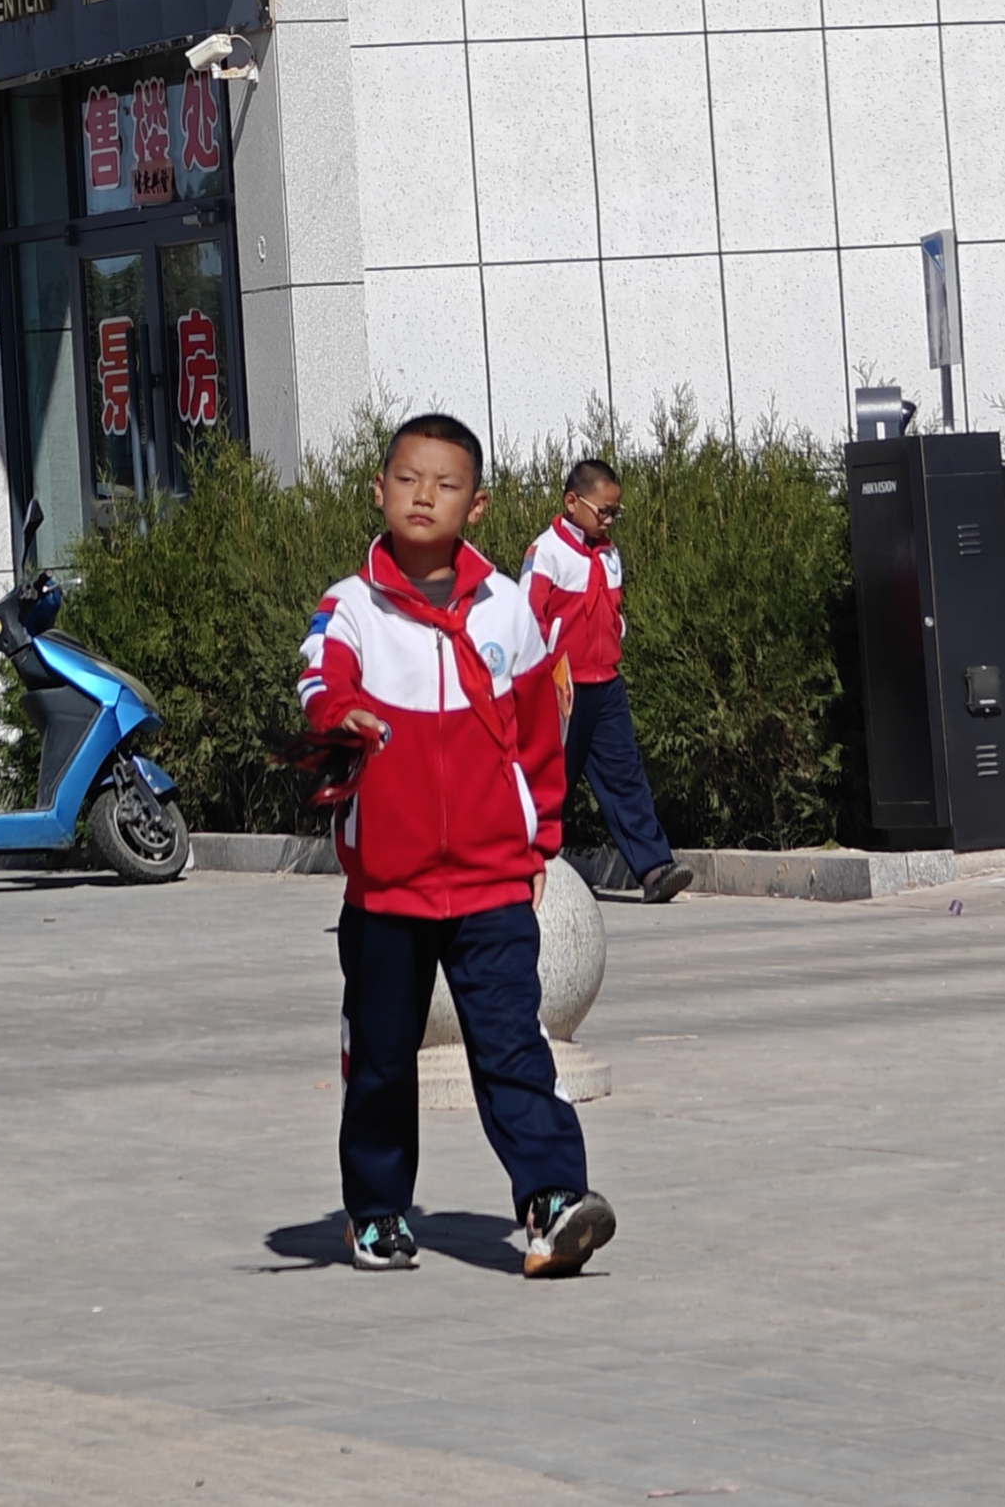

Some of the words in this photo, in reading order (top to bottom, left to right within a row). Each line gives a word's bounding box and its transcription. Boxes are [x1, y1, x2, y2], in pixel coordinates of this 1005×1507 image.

[84, 67, 220, 189] 售楼处
[862, 480, 898, 495] HIKVISION
